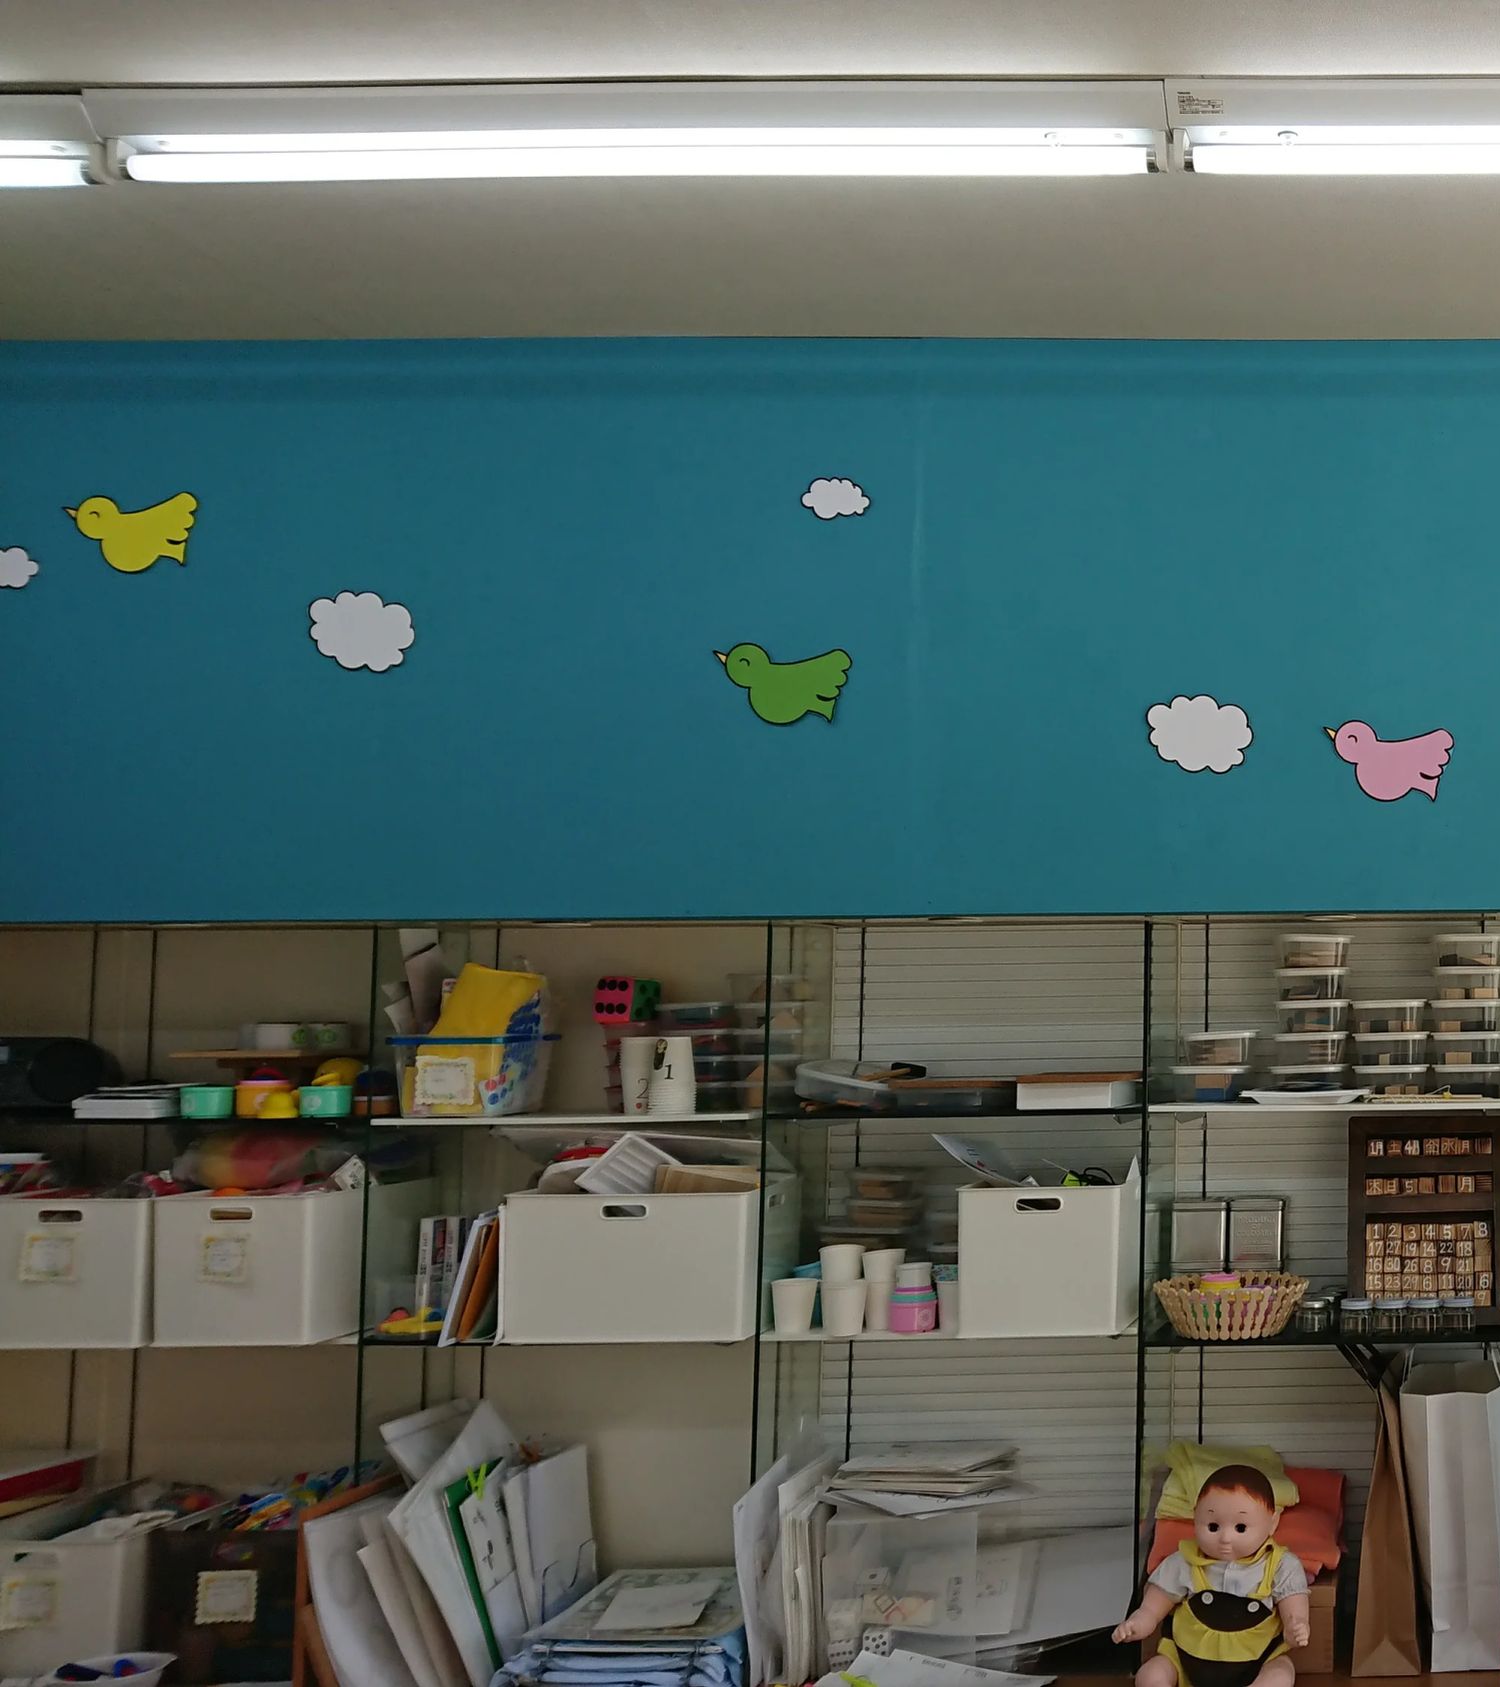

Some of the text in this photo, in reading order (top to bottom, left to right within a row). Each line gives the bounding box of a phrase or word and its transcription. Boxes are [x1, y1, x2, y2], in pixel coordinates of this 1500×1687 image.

[664, 1063, 675, 1080] 1
[636, 1077, 649, 1099] 2
[1460, 1176, 1473, 1193] 月
[1373, 1222, 1488, 1239] 1 2 3 4 5 7 8
[1368, 1241, 1473, 1256] 17 27 19 14 22 18
[1368, 1257, 1470, 1274] 16 30 26 8 9 21
[1368, 1274, 1381, 1289] 15
[1385, 1274, 1401, 1289] 23
[1441, 1274, 1454, 1290] 11
[1458, 1276, 1472, 1290] 20
[1479, 1274, 1489, 1289] 6
